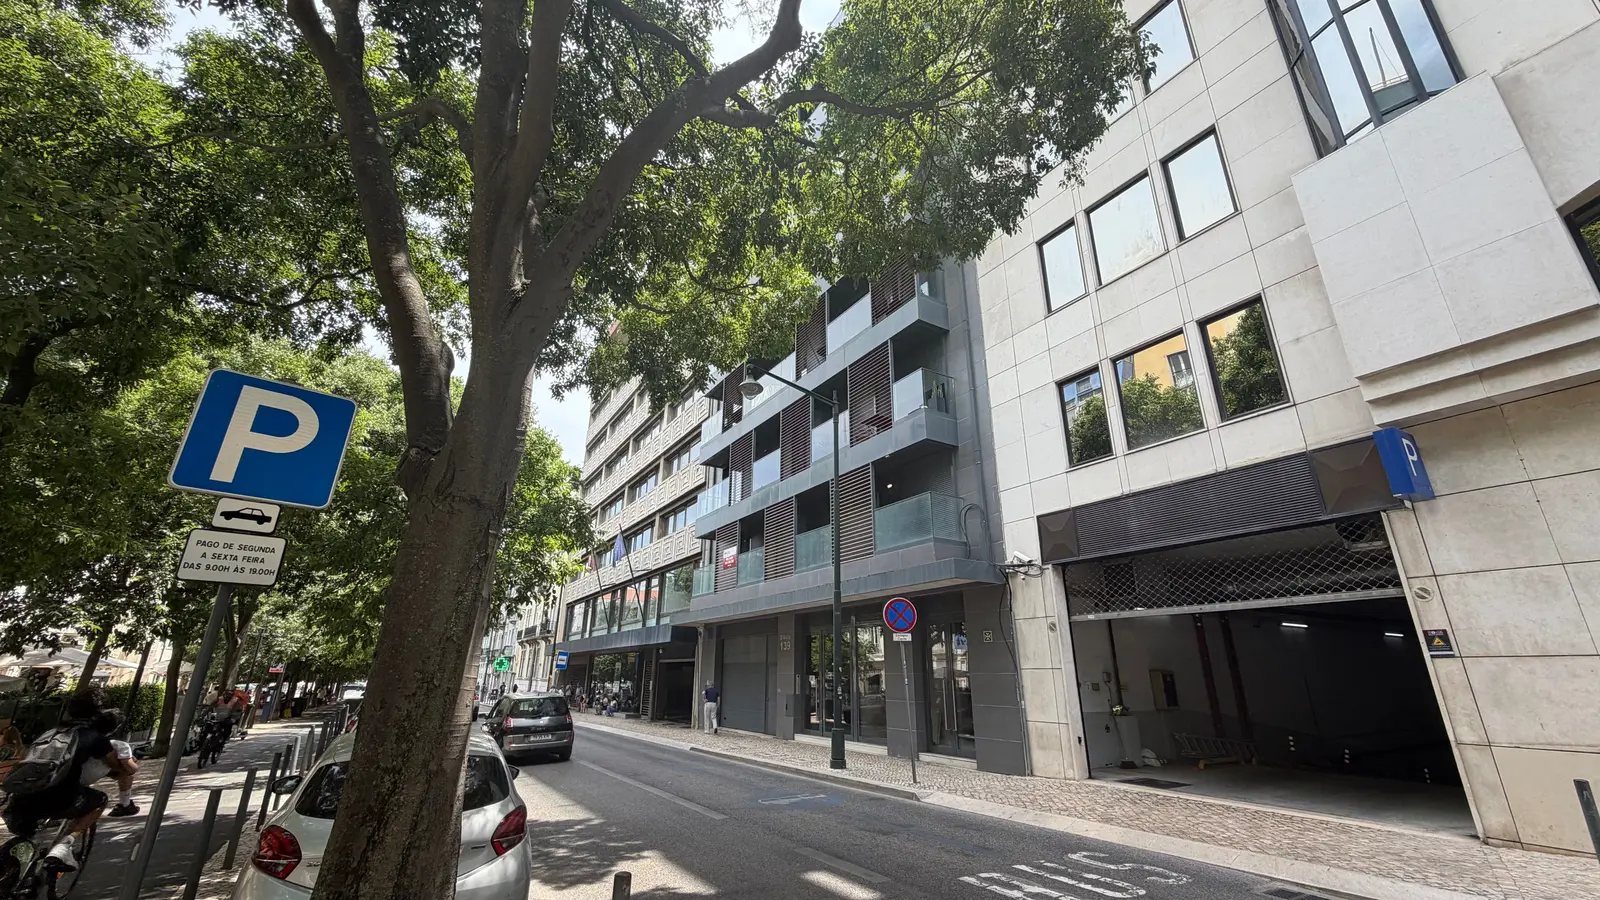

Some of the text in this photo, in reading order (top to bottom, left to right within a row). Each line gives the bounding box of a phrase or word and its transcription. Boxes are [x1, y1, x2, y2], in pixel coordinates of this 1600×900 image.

[209, 385, 320, 483] P
[1401, 437, 1418, 477] P
[195, 540, 220, 548] PAGO
[237, 544, 276, 554] SEGUNDA
[211, 552, 238, 561] SEXTA
[241, 556, 265, 564] FEIRA
[182, 562, 201, 570] DAS
[204, 564, 230, 572] 9.00H
[249, 568, 276, 576] 19.00H
[780, 640, 791, 651] 139
